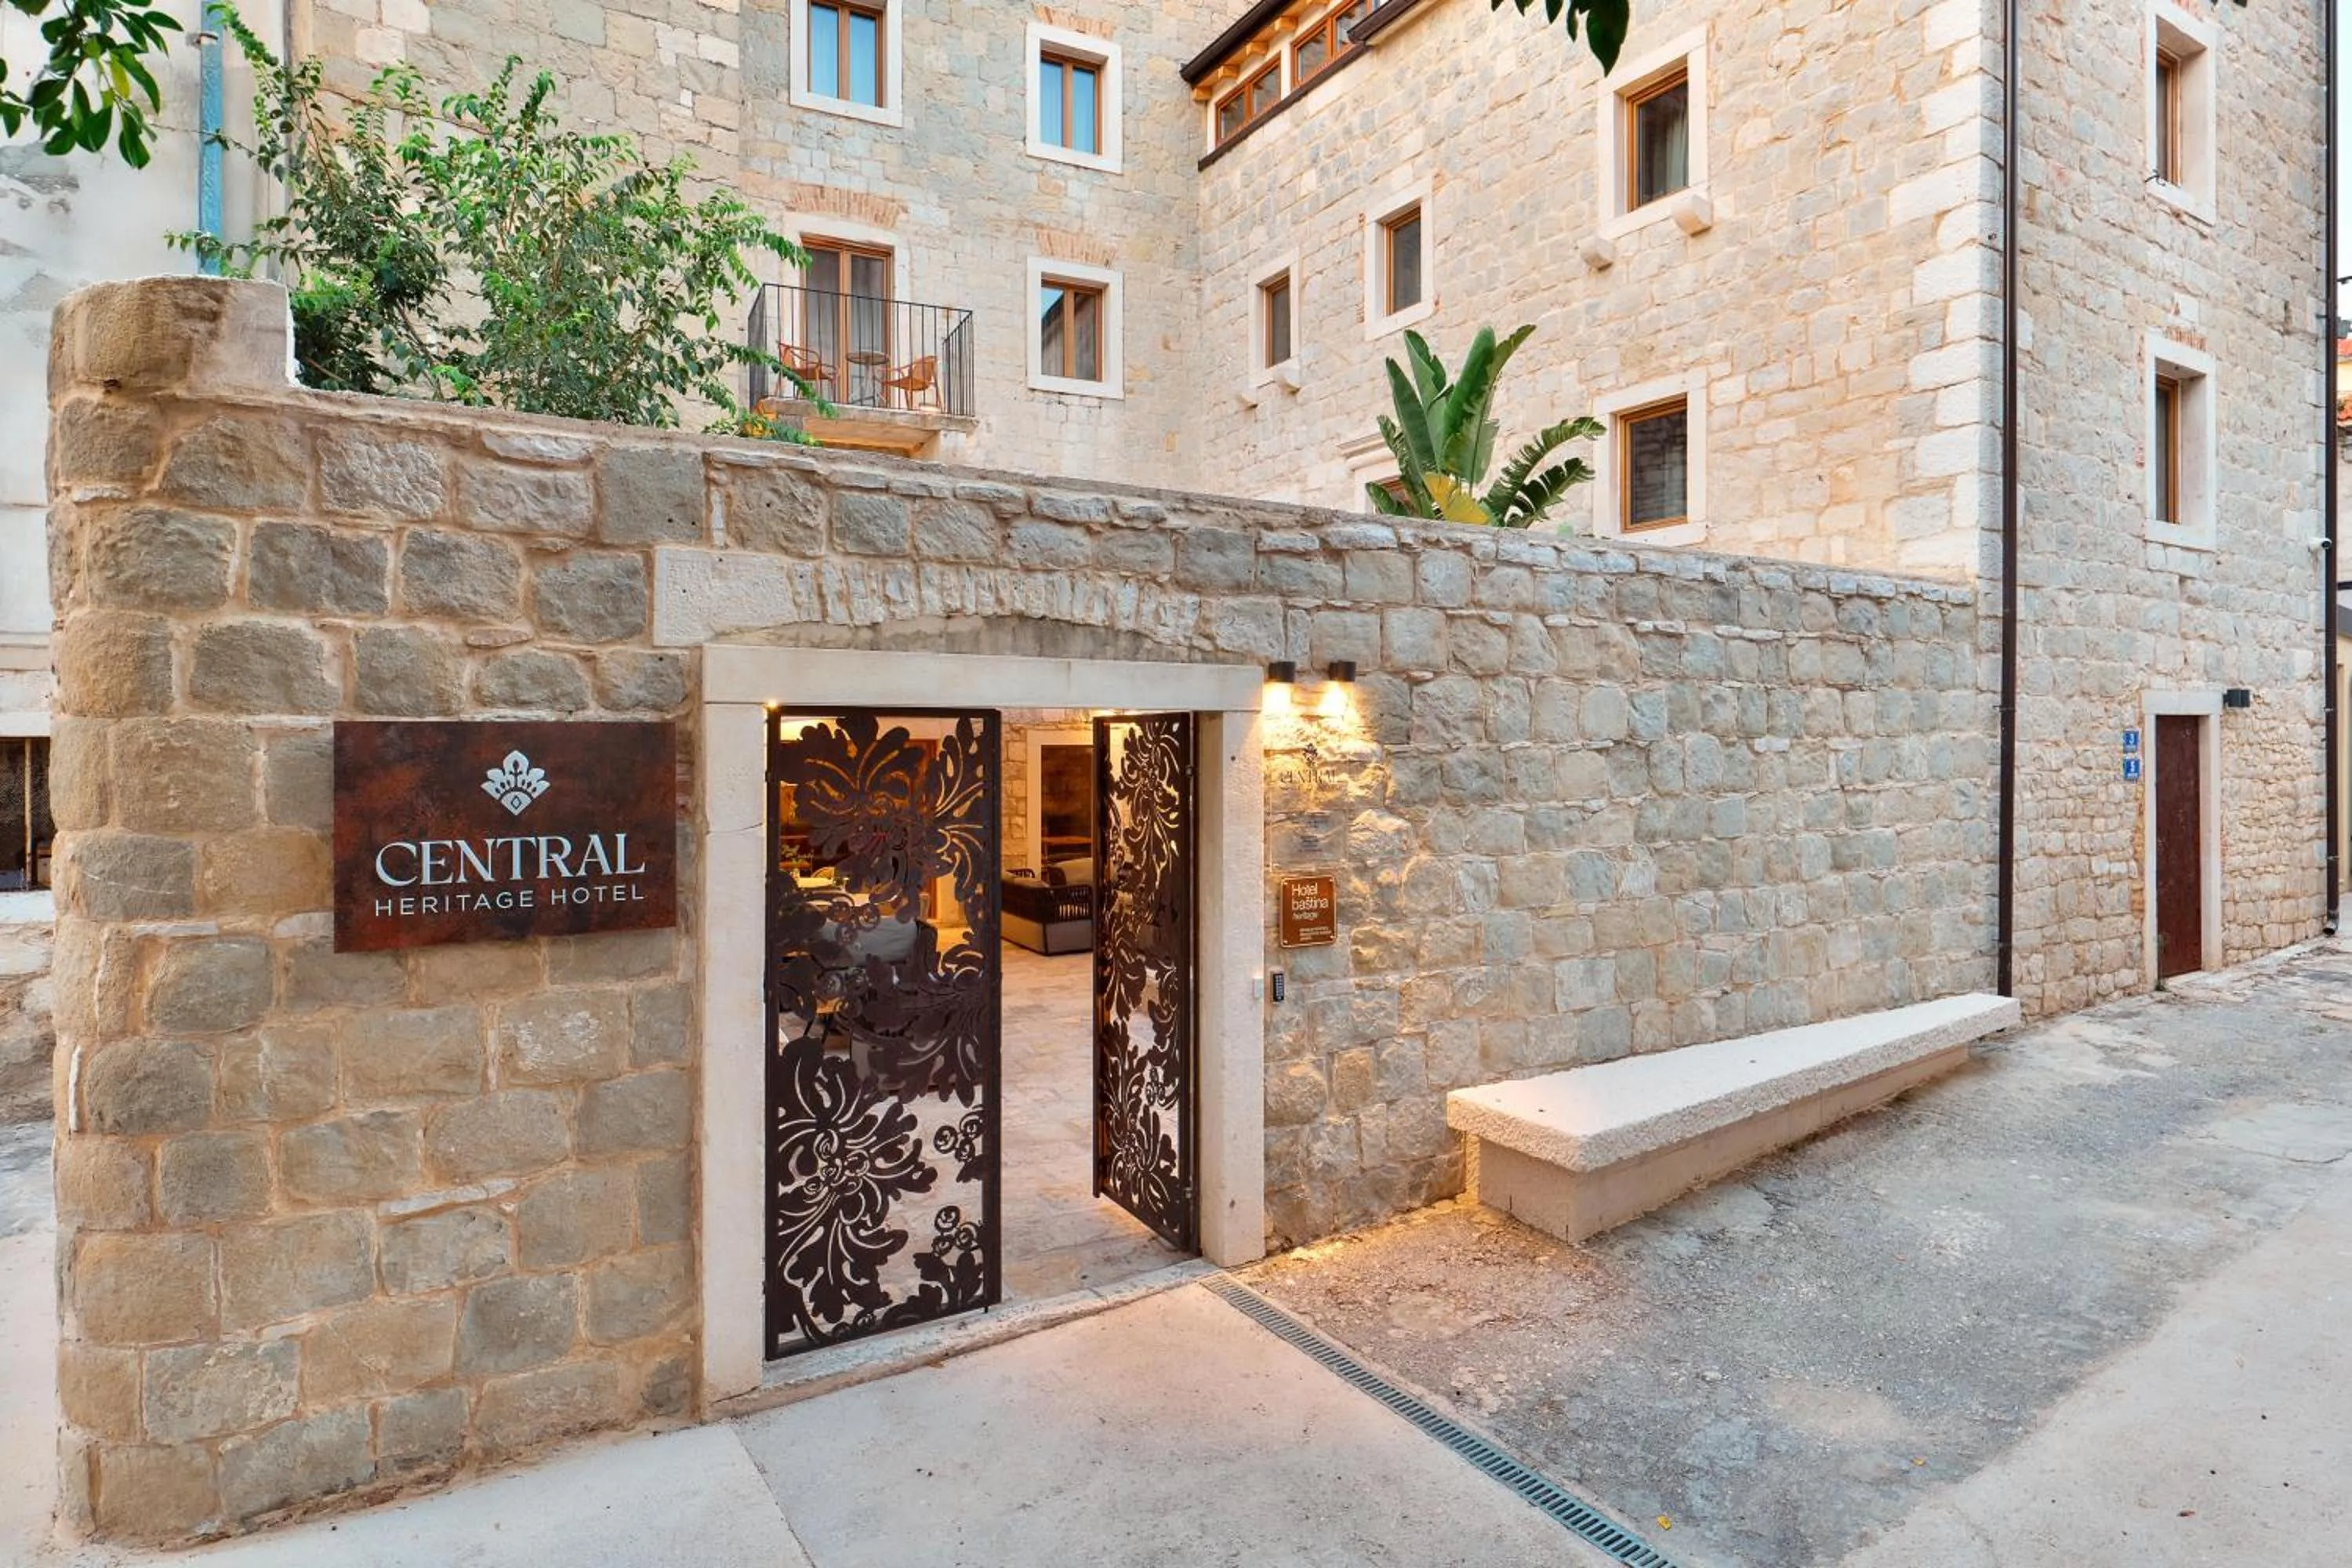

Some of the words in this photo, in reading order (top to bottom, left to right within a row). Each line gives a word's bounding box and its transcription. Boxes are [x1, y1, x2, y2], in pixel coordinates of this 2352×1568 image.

[375, 833, 646, 887] CENTRAL
[375, 890, 535, 916] HERITAGE
[550, 884, 645, 906] HOTEL
[1291, 882, 1318, 897] Hotel
[1291, 896, 1329, 910] baština
